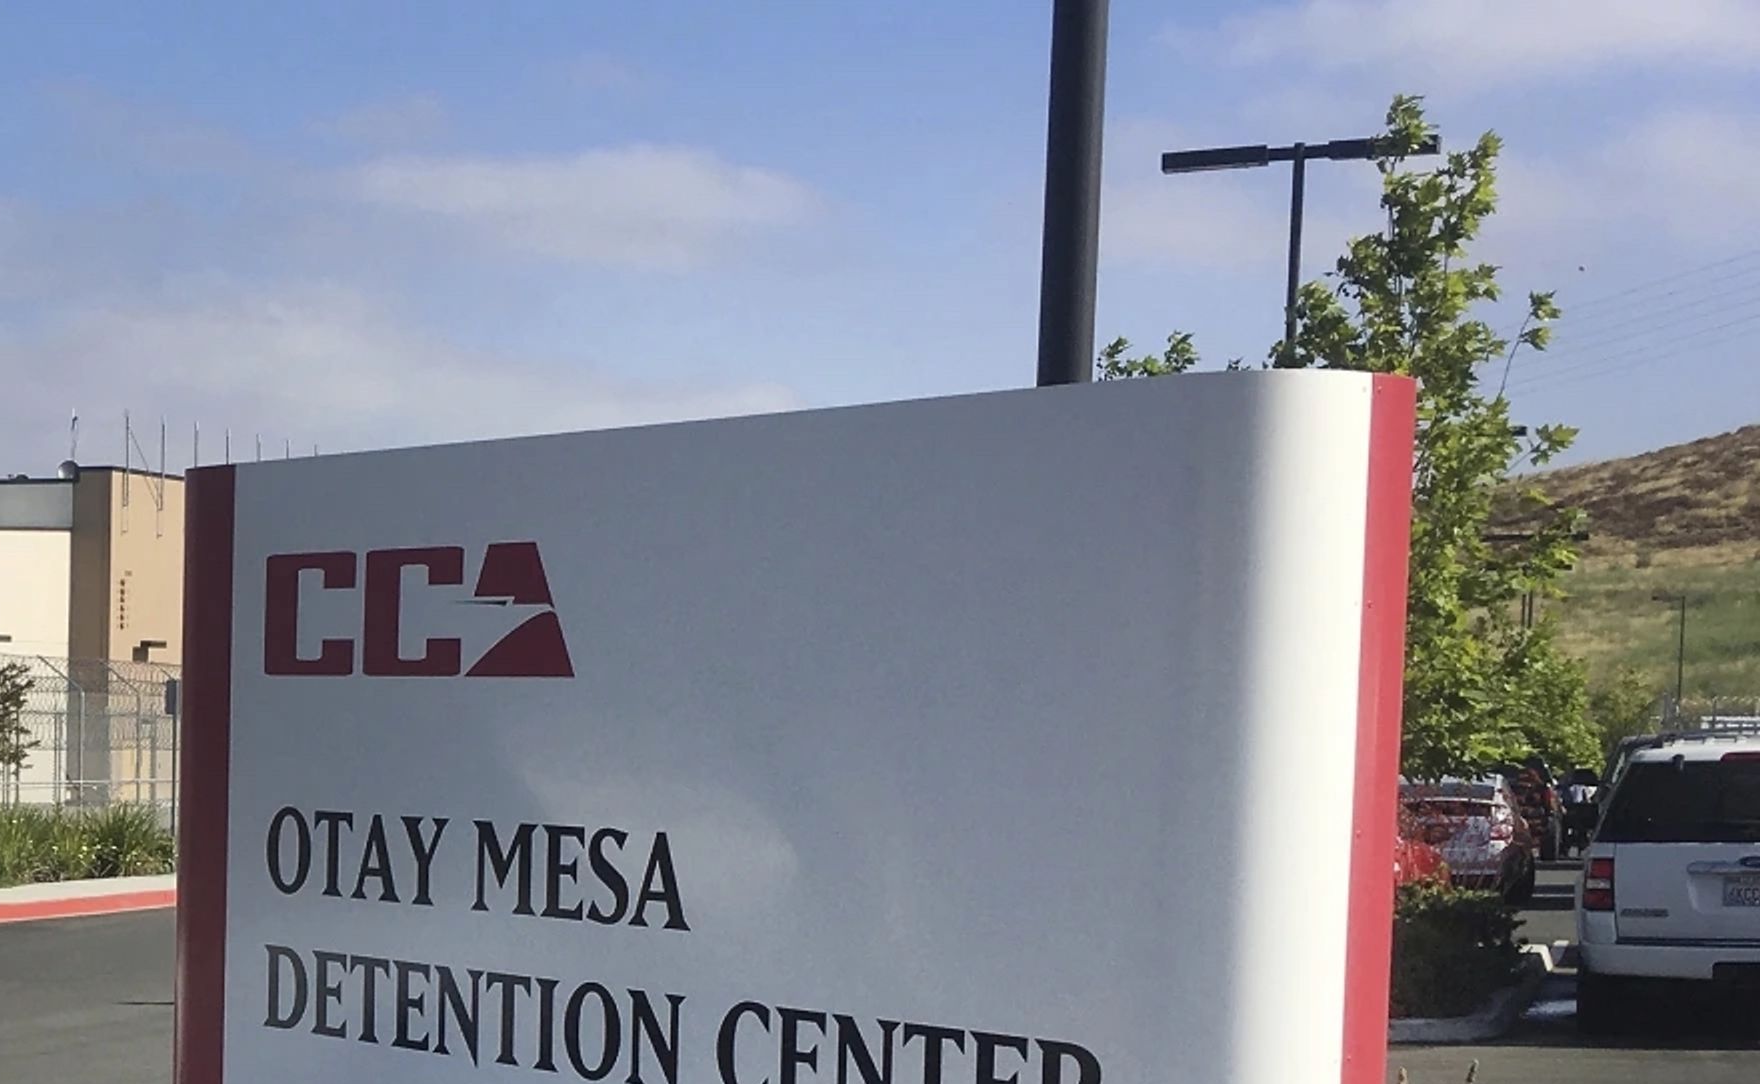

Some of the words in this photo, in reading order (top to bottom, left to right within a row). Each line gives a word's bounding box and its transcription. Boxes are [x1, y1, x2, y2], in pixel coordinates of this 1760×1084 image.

[263, 541, 576, 679] CCA
[266, 806, 451, 907] OTAY
[470, 820, 691, 932] MESA
